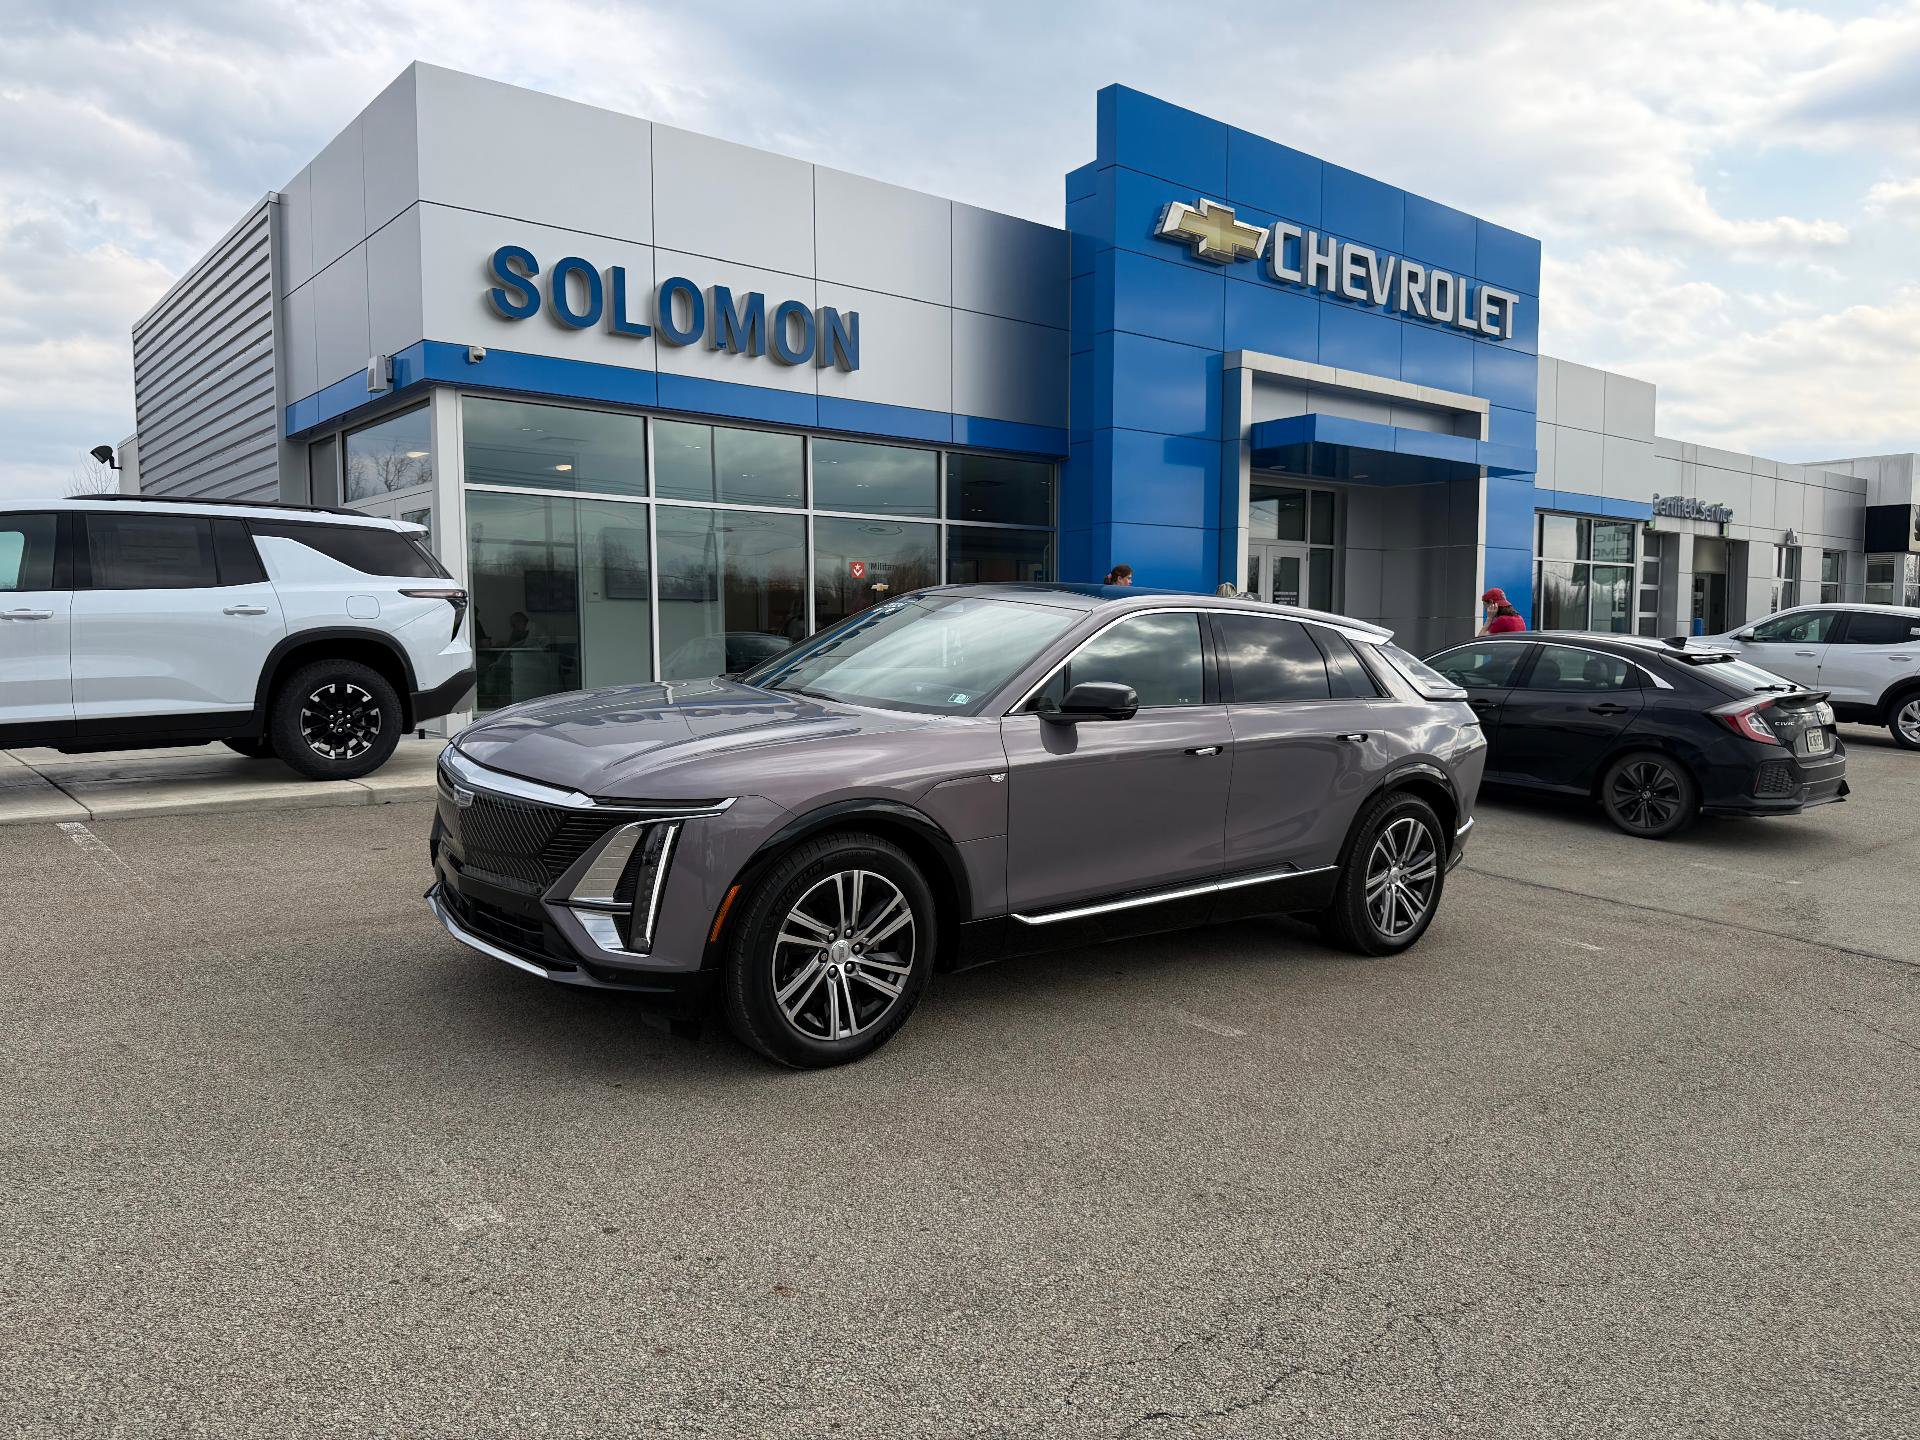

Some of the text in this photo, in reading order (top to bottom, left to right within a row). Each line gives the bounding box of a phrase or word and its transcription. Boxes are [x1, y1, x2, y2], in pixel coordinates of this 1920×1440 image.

[485, 245, 860, 372] SOLOMON
[1268, 221, 1520, 340] CHEVROLET
[1652, 492, 1734, 523] Certified Service
